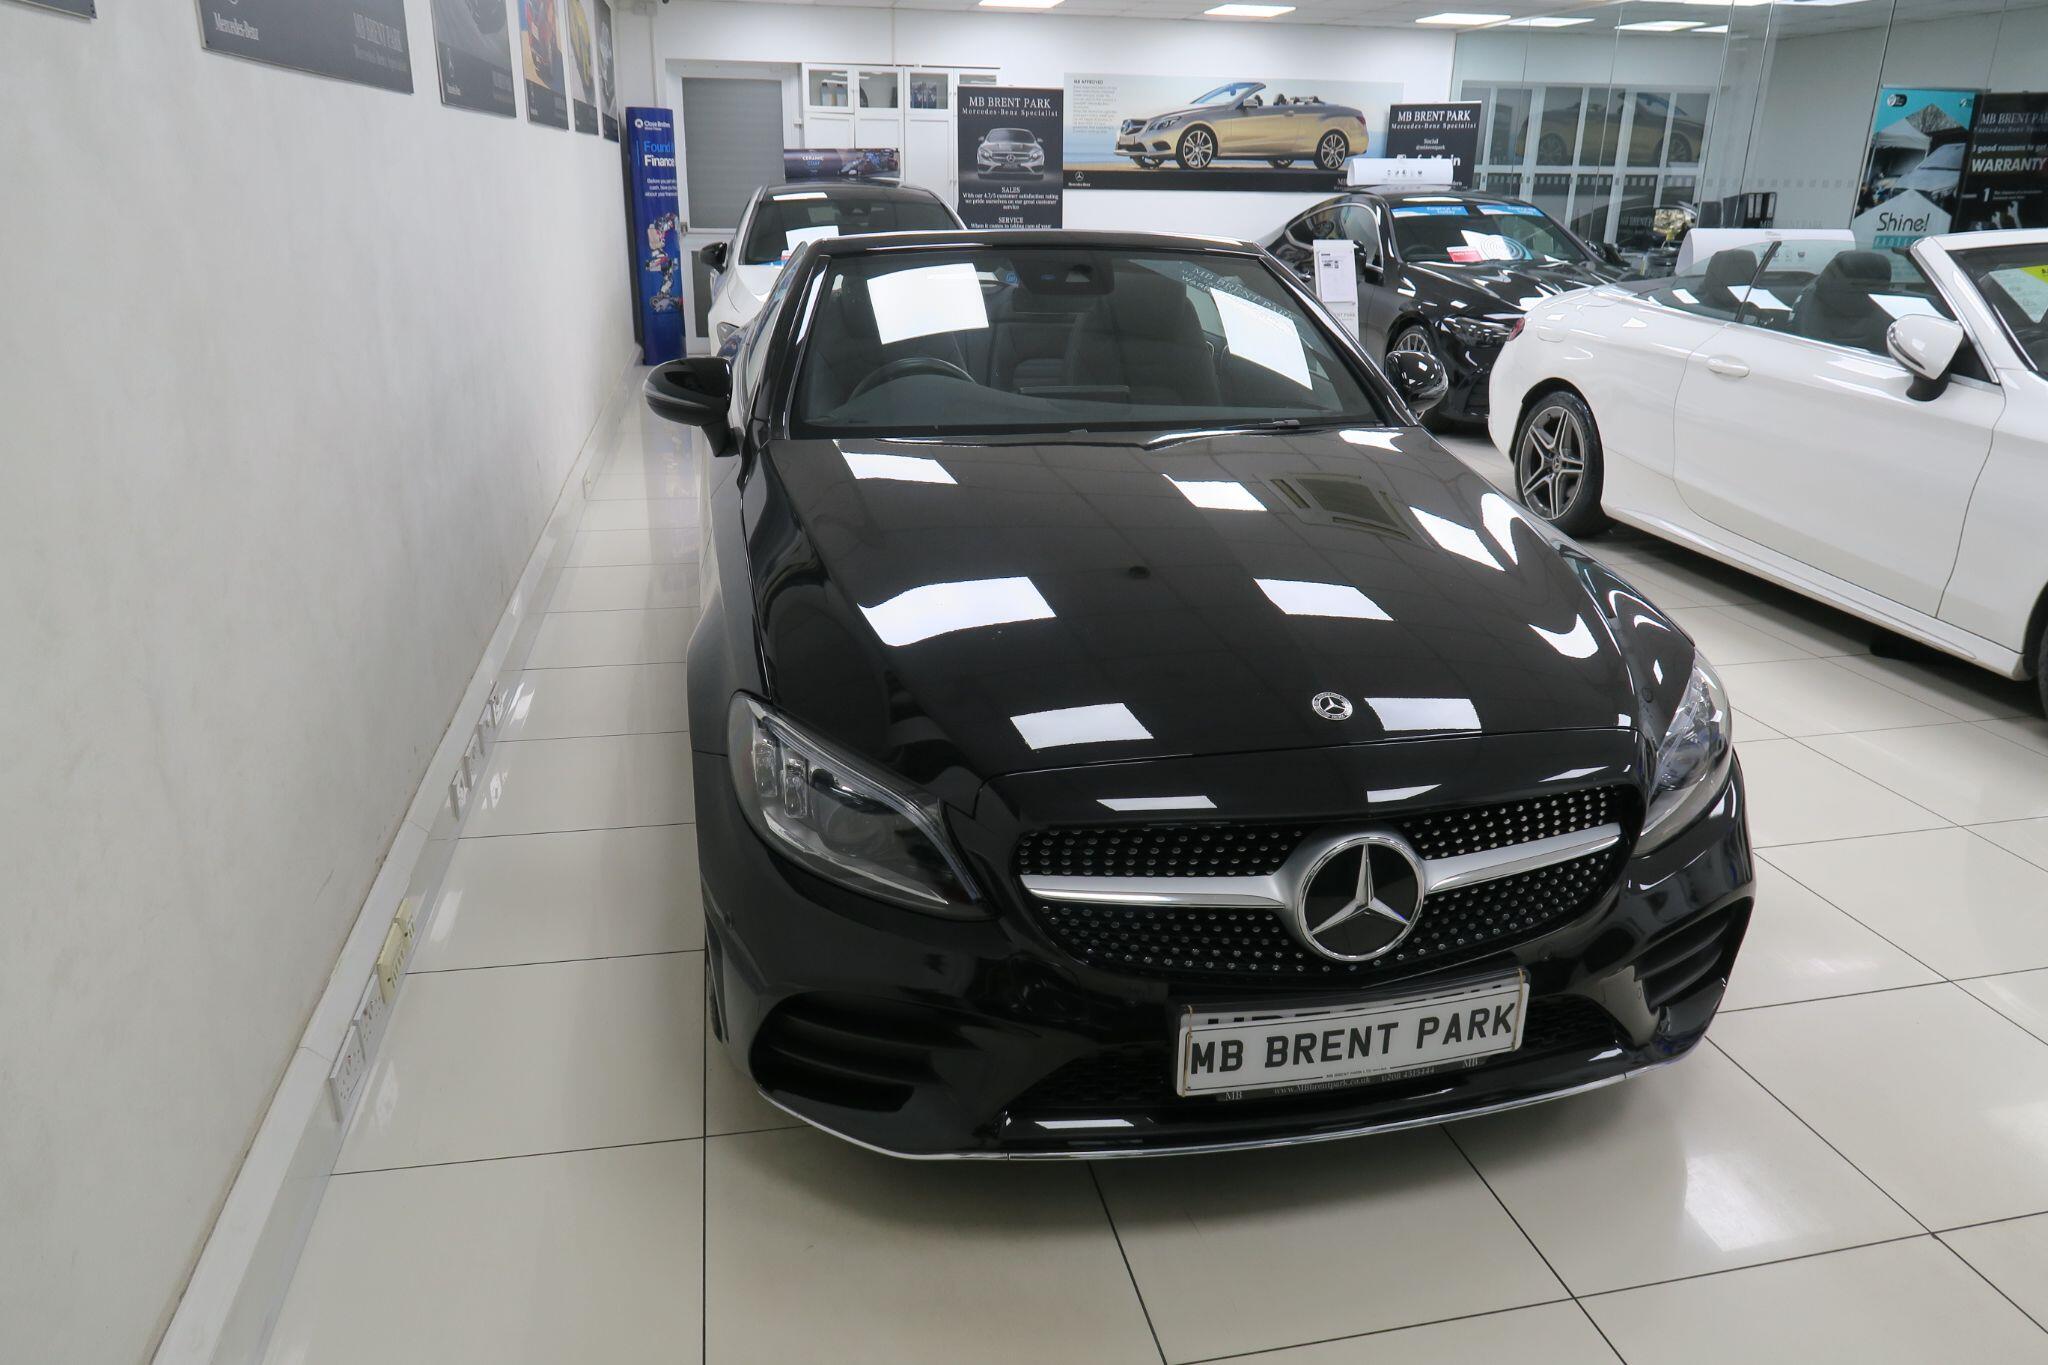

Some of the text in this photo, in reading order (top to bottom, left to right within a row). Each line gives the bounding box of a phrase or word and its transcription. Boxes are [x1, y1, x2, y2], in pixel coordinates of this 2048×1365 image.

[213, 11, 260, 41] Mercedes-Benz
[969, 97, 1051, 109] MB BRENT PARK
[962, 107, 1058, 117] Mercedes-Benz Specialist
[1397, 109, 1471, 122] MB BRENT PARK
[1981, 113, 1996, 124] MB
[1998, 113, 2030, 123] BRENT
[1442, 122, 1476, 130] Specialist
[643, 140, 671, 153] Found
[1978, 144, 1996, 153] good
[1971, 158, 2048, 173] WARRANTY
[1983, 187, 1991, 202] 1
[1876, 212, 1931, 232] Shine!
[1190, 1002, 1516, 1075] MB BRENT PARK
[1224, 1090, 1243, 1101] MB
